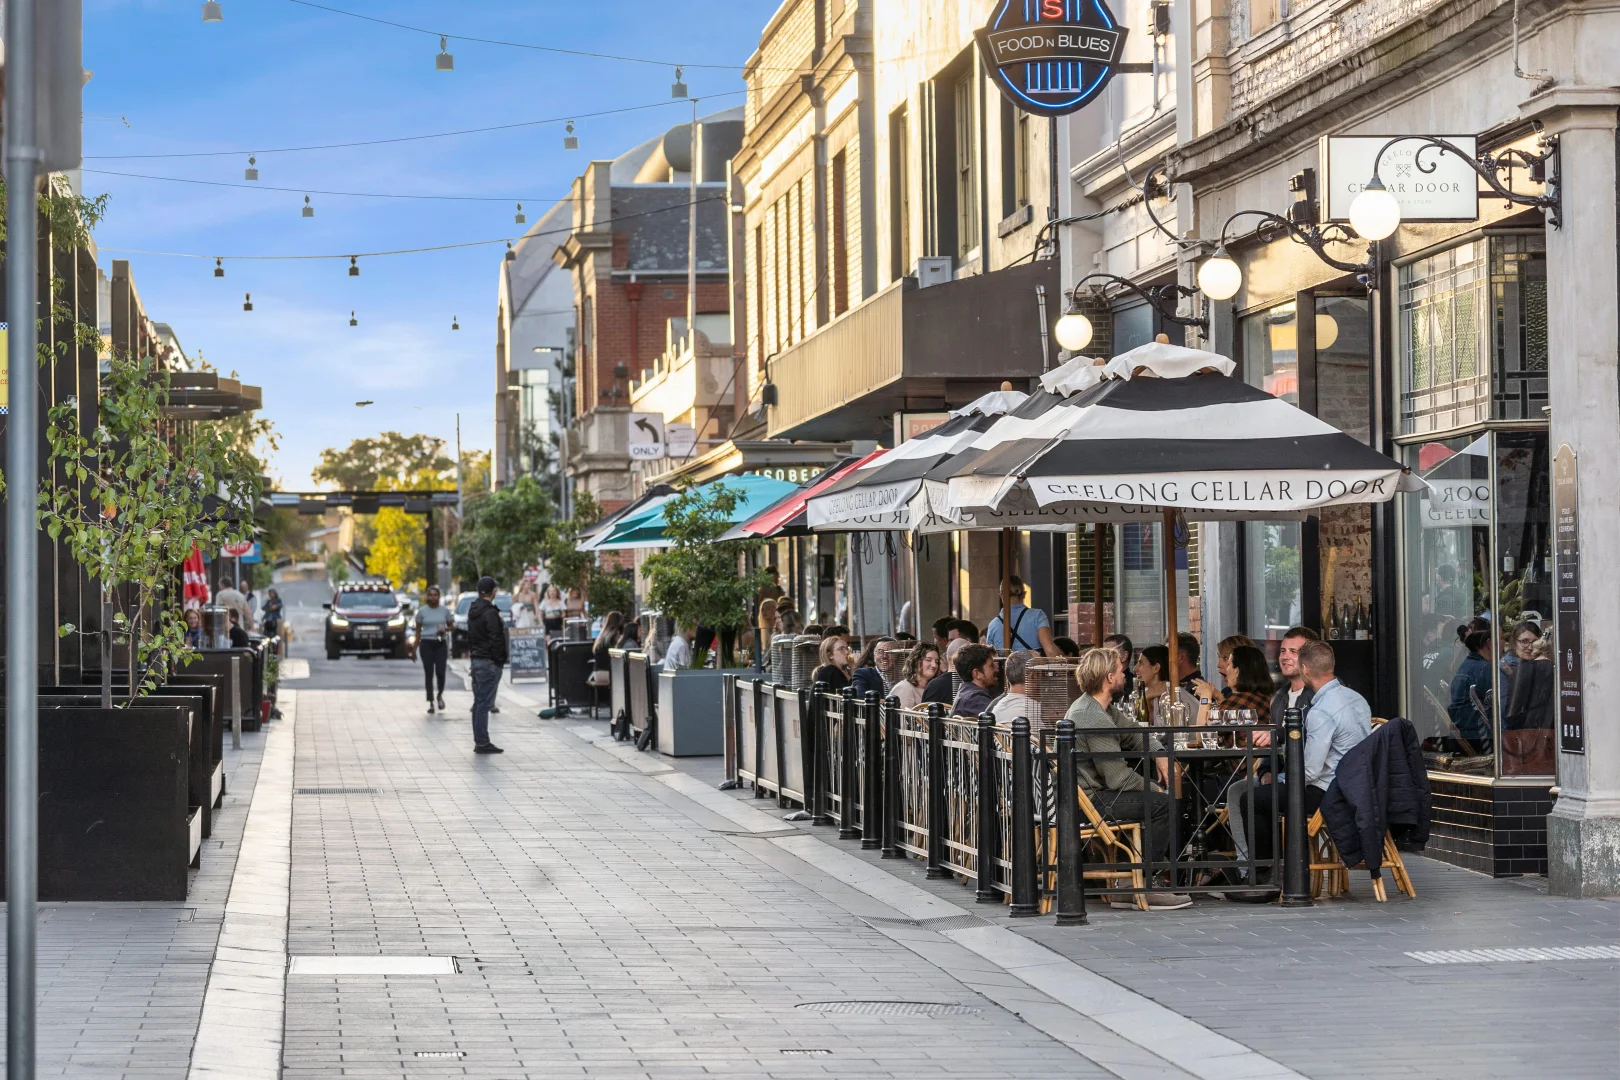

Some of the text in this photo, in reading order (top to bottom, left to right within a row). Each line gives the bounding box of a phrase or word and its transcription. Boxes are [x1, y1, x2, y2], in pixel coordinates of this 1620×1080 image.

[997, 34, 1111, 54] FOOD N BLUES
[1347, 182, 1461, 193] CEAR DOOR
[632, 447, 660, 456] ONLY
[1047, 477, 1386, 503] GEELONG CELLAR DOOR
[854, 491, 876, 510] CELLAR
